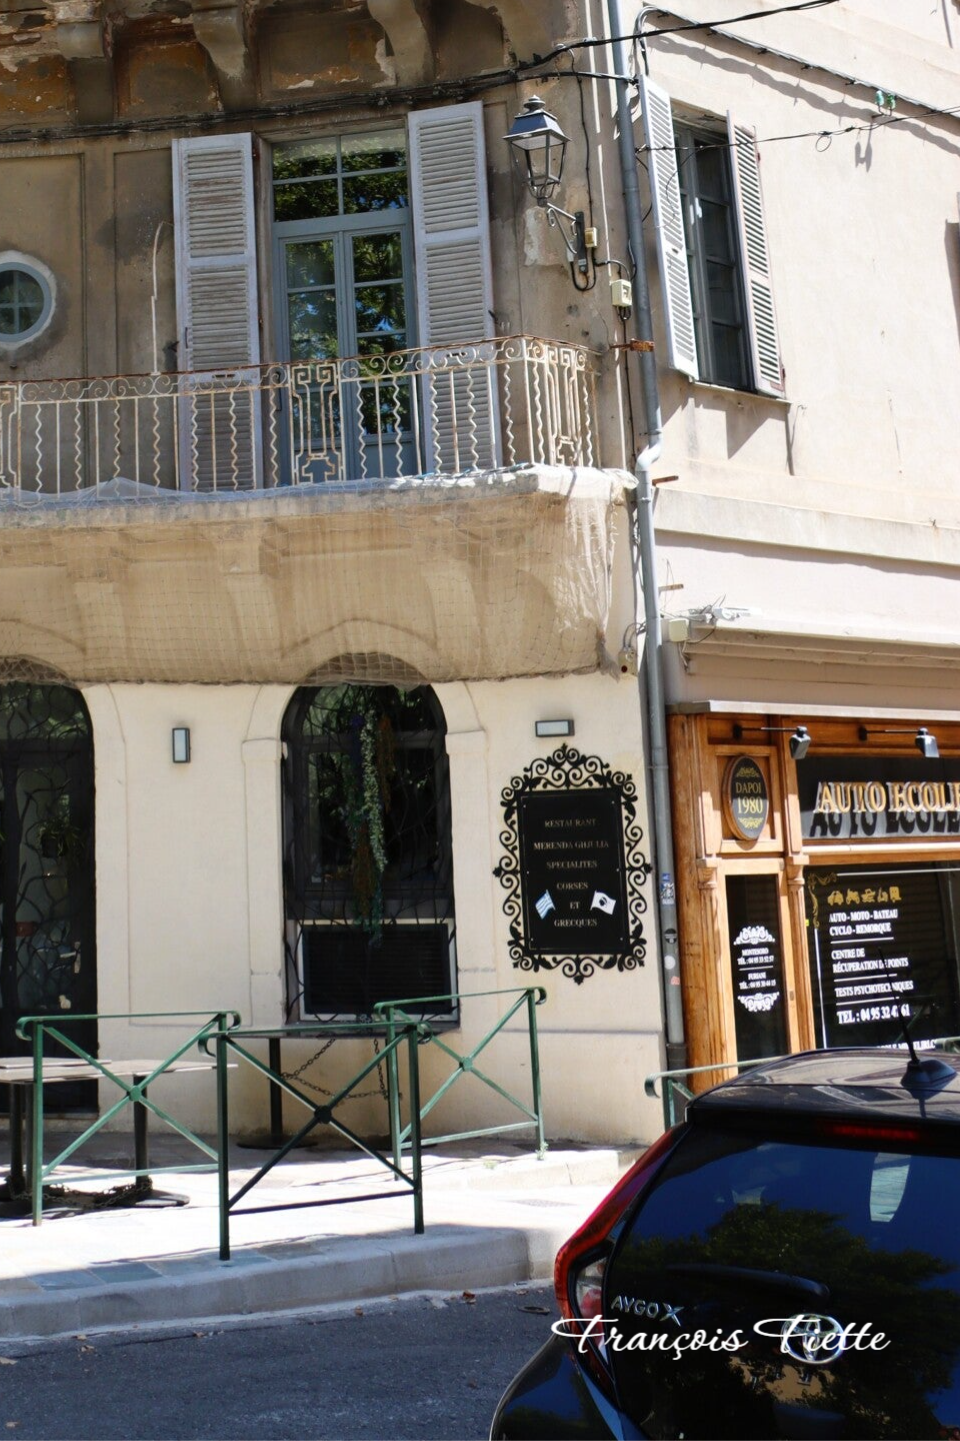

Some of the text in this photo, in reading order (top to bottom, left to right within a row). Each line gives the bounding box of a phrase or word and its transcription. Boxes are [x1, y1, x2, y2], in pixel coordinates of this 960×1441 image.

[735, 781, 762, 794] DAPOI
[813, 781, 887, 813] AUTO
[737, 796, 764, 815] 1980
[544, 818, 596, 828] RESTAURANT
[533, 841, 574, 850] MERENDA
[546, 860, 598, 869] SPECIALITES
[556, 882, 589, 890] CORSES
[569, 901, 580, 910] ET
[829, 912, 847, 923] AUTO
[850, 910, 870, 922] MOTO
[873, 908, 899, 920] BATEAU
[553, 919, 598, 928] GRECQUES
[829, 925, 852, 936] CYCLO
[855, 922, 892, 934] REMORQUE
[831, 947, 866, 960] CENTRE DE
[888, 957, 909, 968] POINTS
[834, 986, 854, 997] TESTS
[836, 1010, 856, 1025] TEL
[860, 1008, 871, 1021] 04
[870, 1006, 880, 1020] 95
[880, 1005, 891, 1019] 32
[900, 1003, 910, 1017] 61
[610, 1295, 659, 1319] AYGO
